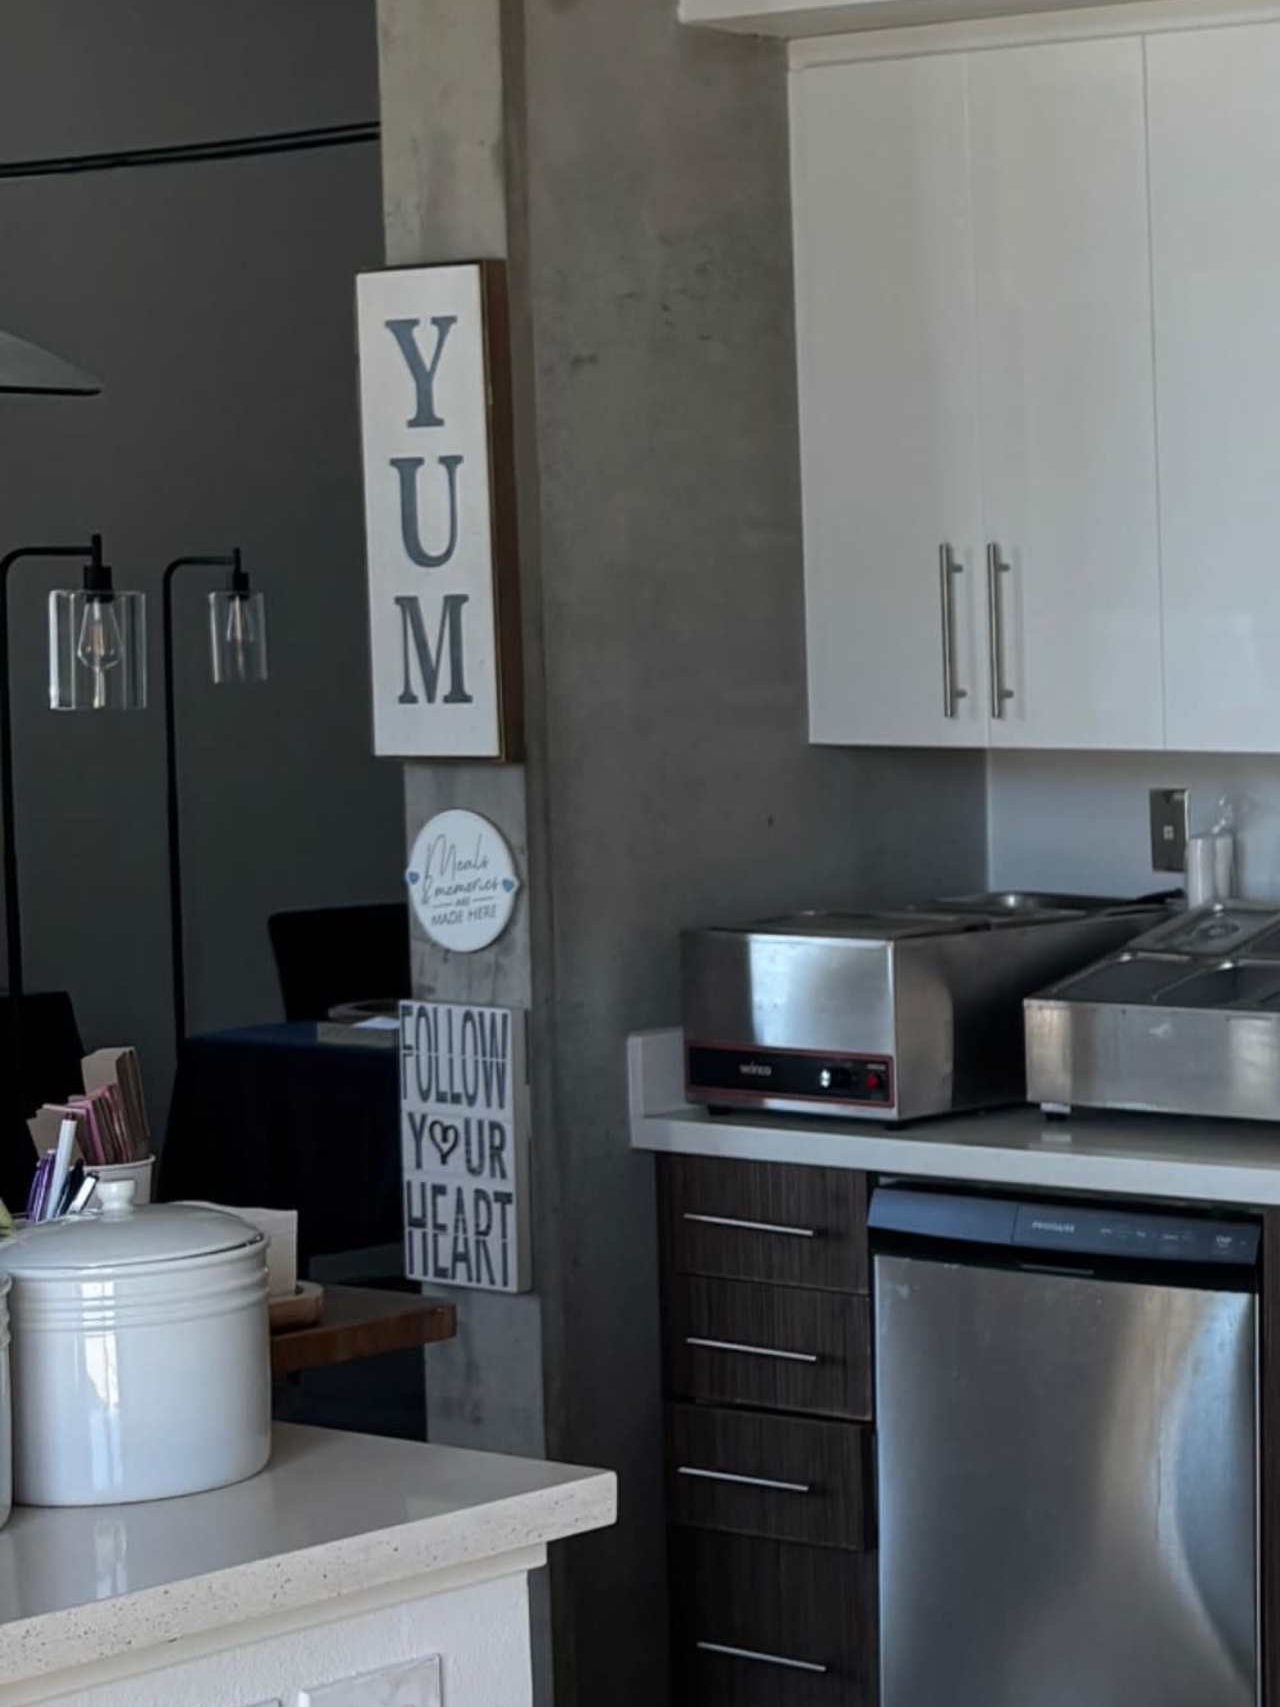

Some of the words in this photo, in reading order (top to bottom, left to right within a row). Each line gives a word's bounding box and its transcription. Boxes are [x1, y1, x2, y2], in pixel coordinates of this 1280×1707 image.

[431, 908, 464, 926] MADE
[467, 904, 497, 922] HERE
[401, 1004, 508, 1110] FOLLOW
[406, 1179, 513, 1288] HEART
